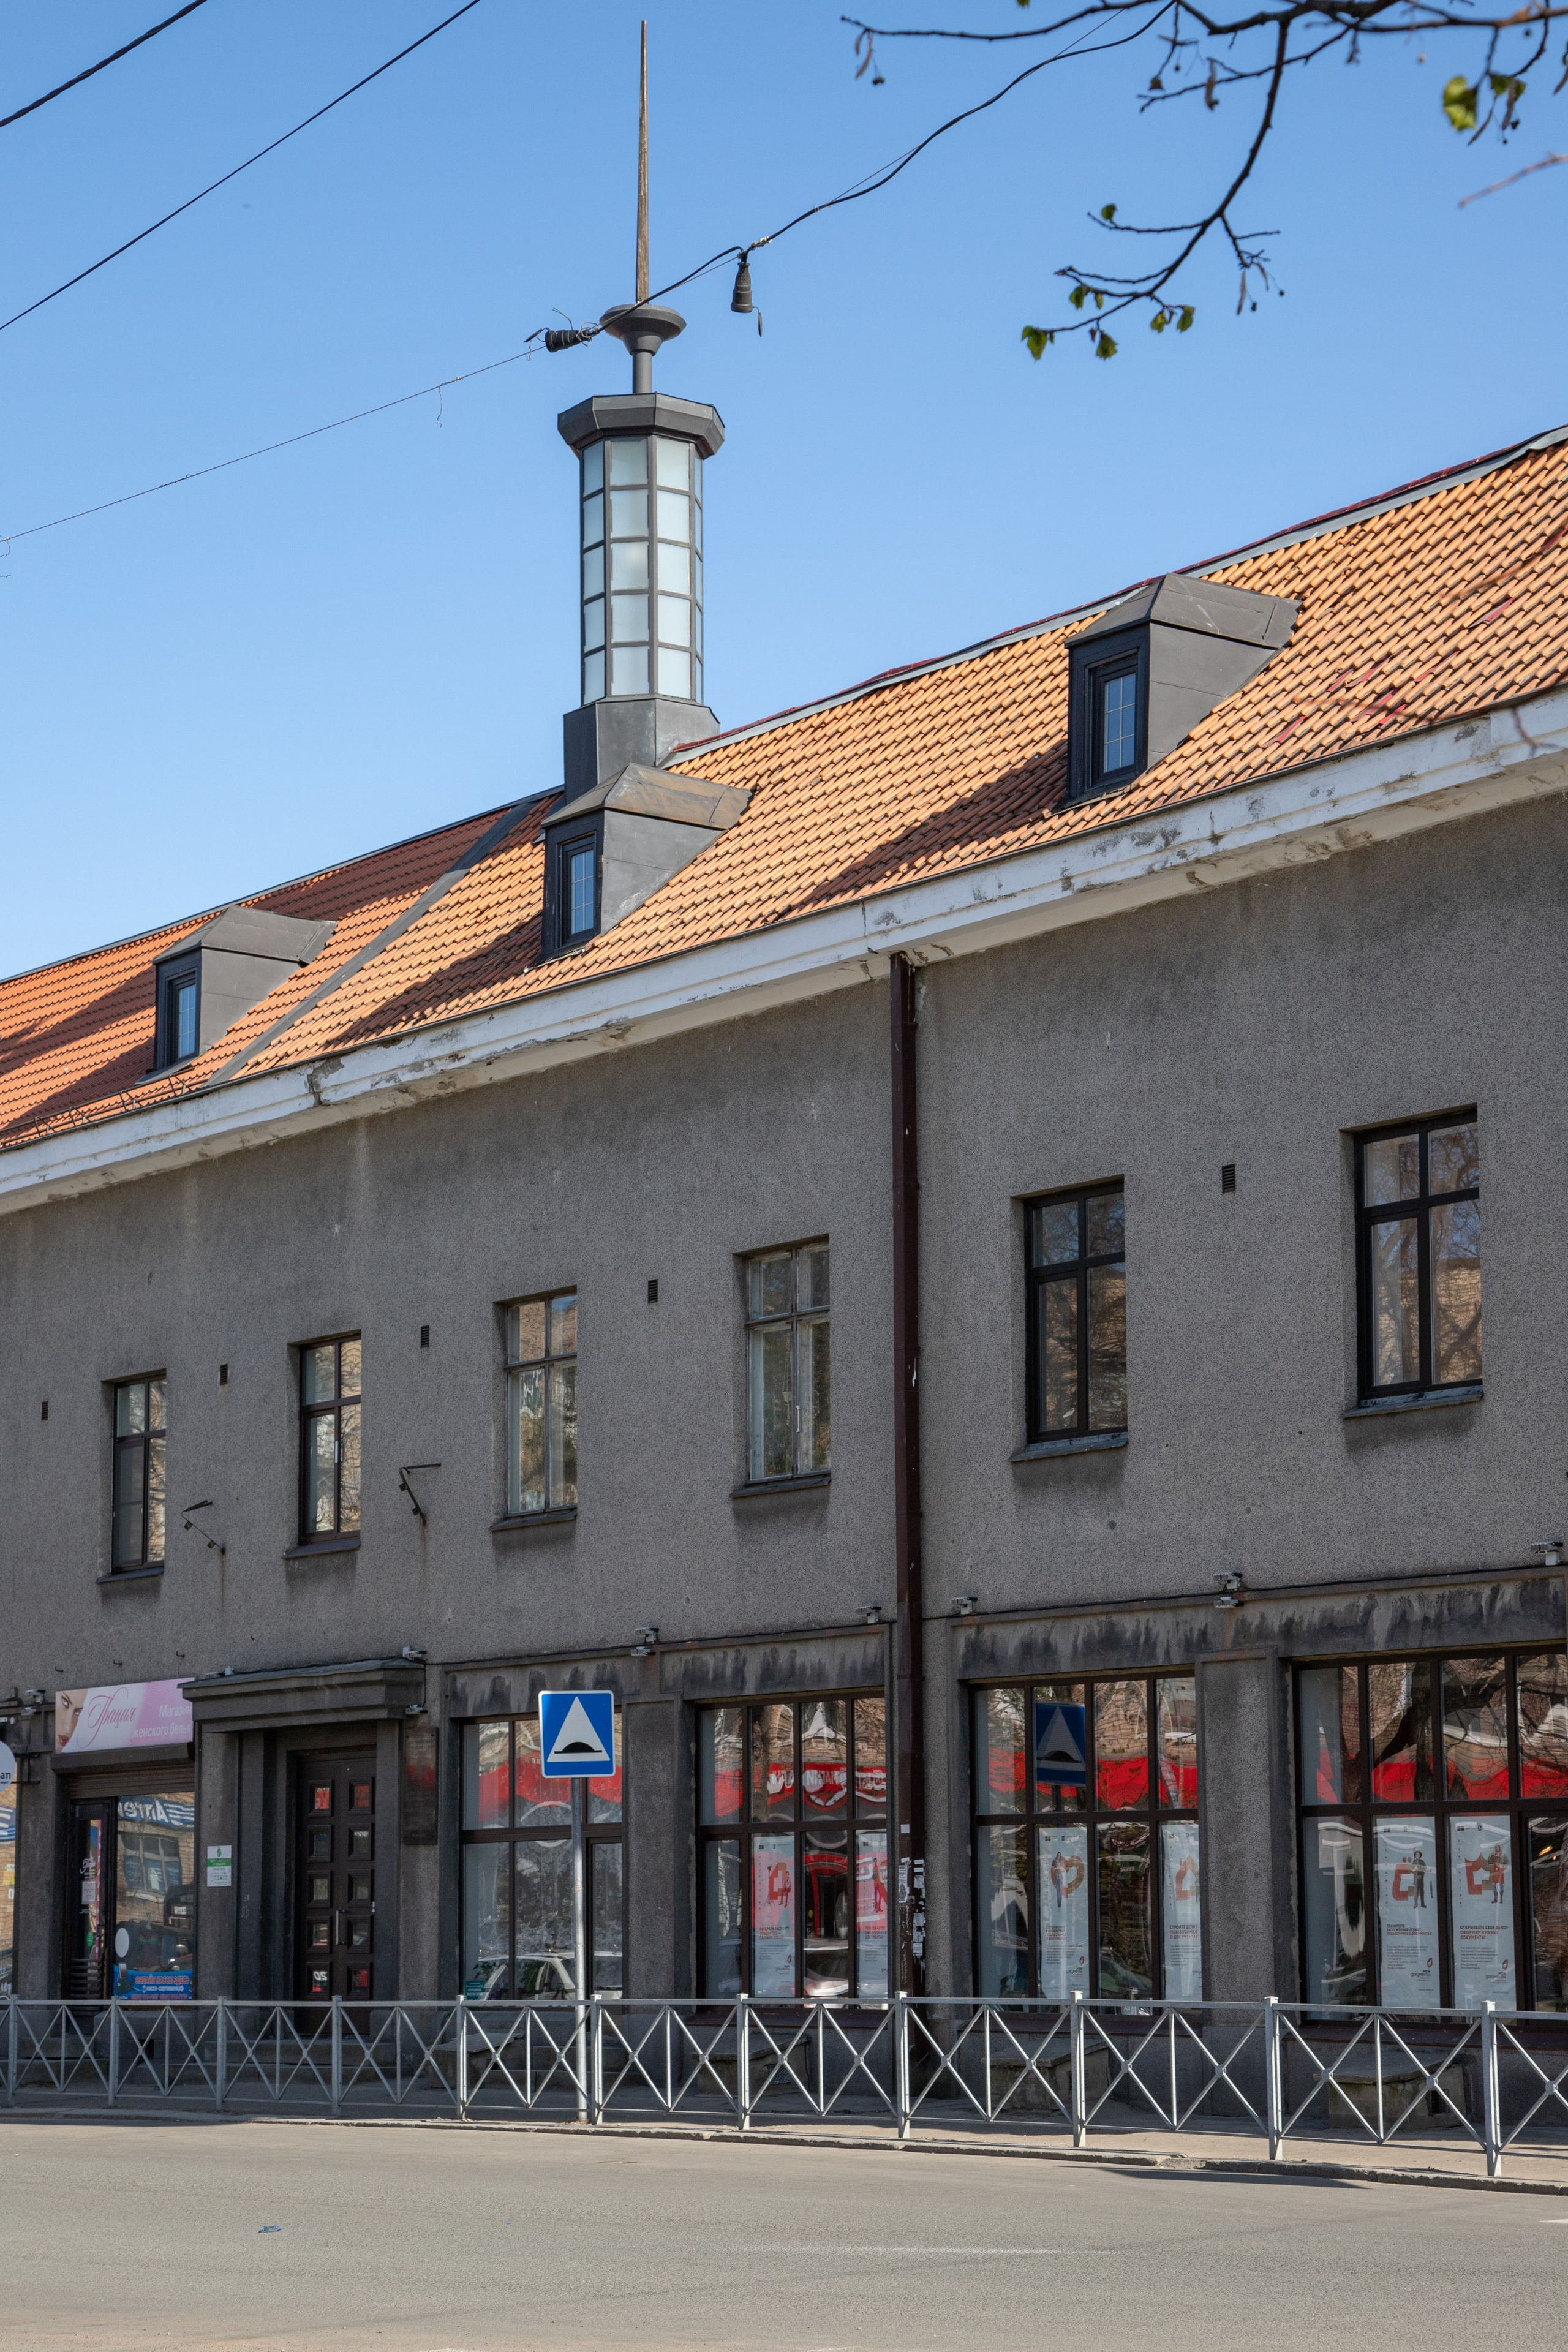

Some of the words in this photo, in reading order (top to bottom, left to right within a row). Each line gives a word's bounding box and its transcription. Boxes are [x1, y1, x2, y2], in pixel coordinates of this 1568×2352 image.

[77, 1687, 140, 1748] Грация
[159, 1704, 192, 1718] Магазин
[132, 1727, 168, 1739] женского
[170, 1722, 192, 1736] белья
